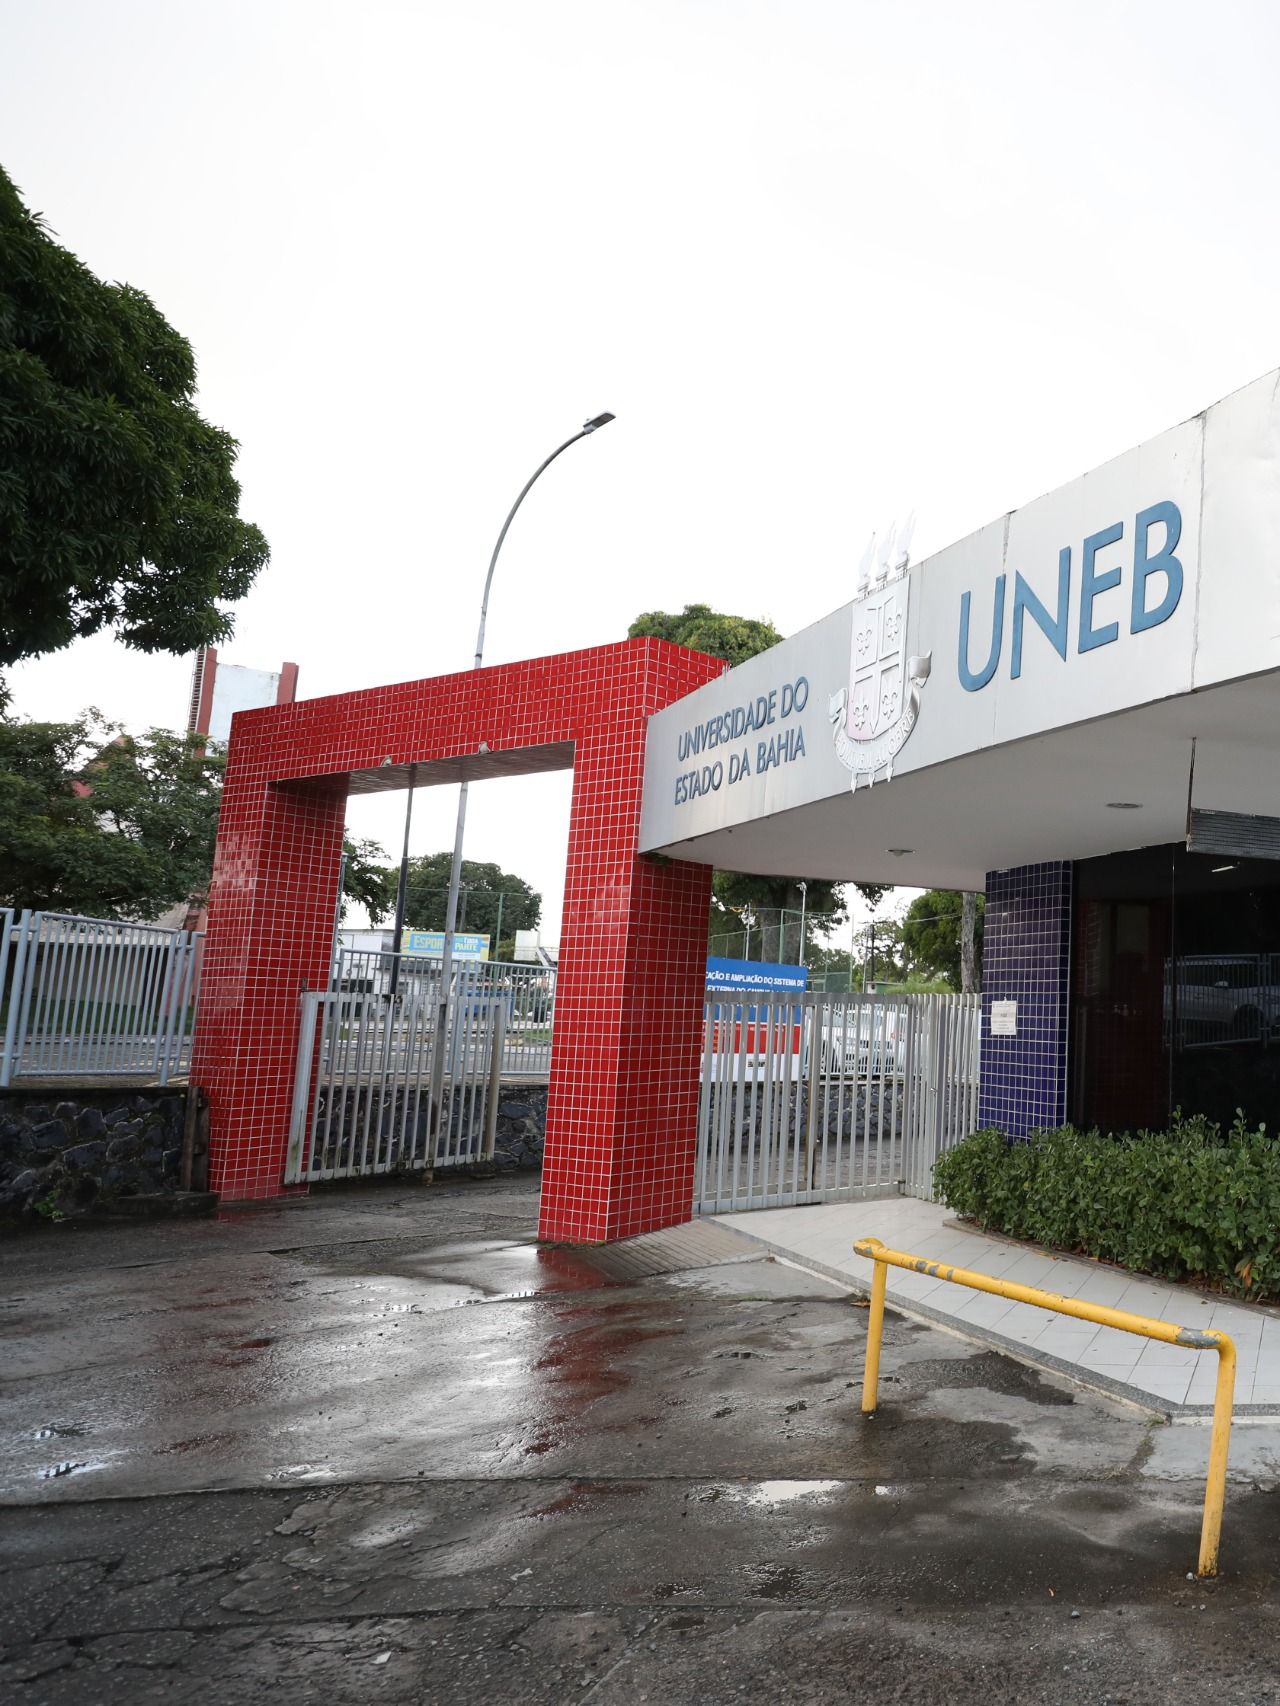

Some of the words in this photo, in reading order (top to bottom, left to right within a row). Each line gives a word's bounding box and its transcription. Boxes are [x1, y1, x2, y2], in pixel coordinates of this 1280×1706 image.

[957, 500, 1184, 692] UNEB
[677, 689, 777, 762] UNIVERSIDADE
[780, 676, 809, 719] DO
[674, 761, 724, 806] ESTADO
[728, 747, 751, 785] DA
[756, 724, 806, 774] BAHIA
[726, 973, 731, 981] E
[731, 973, 763, 984] AMPLIAÇÃO
[763, 976, 773, 985] DO
[773, 978, 797, 987] SISTEMA
[797, 979, 805, 987] DE
